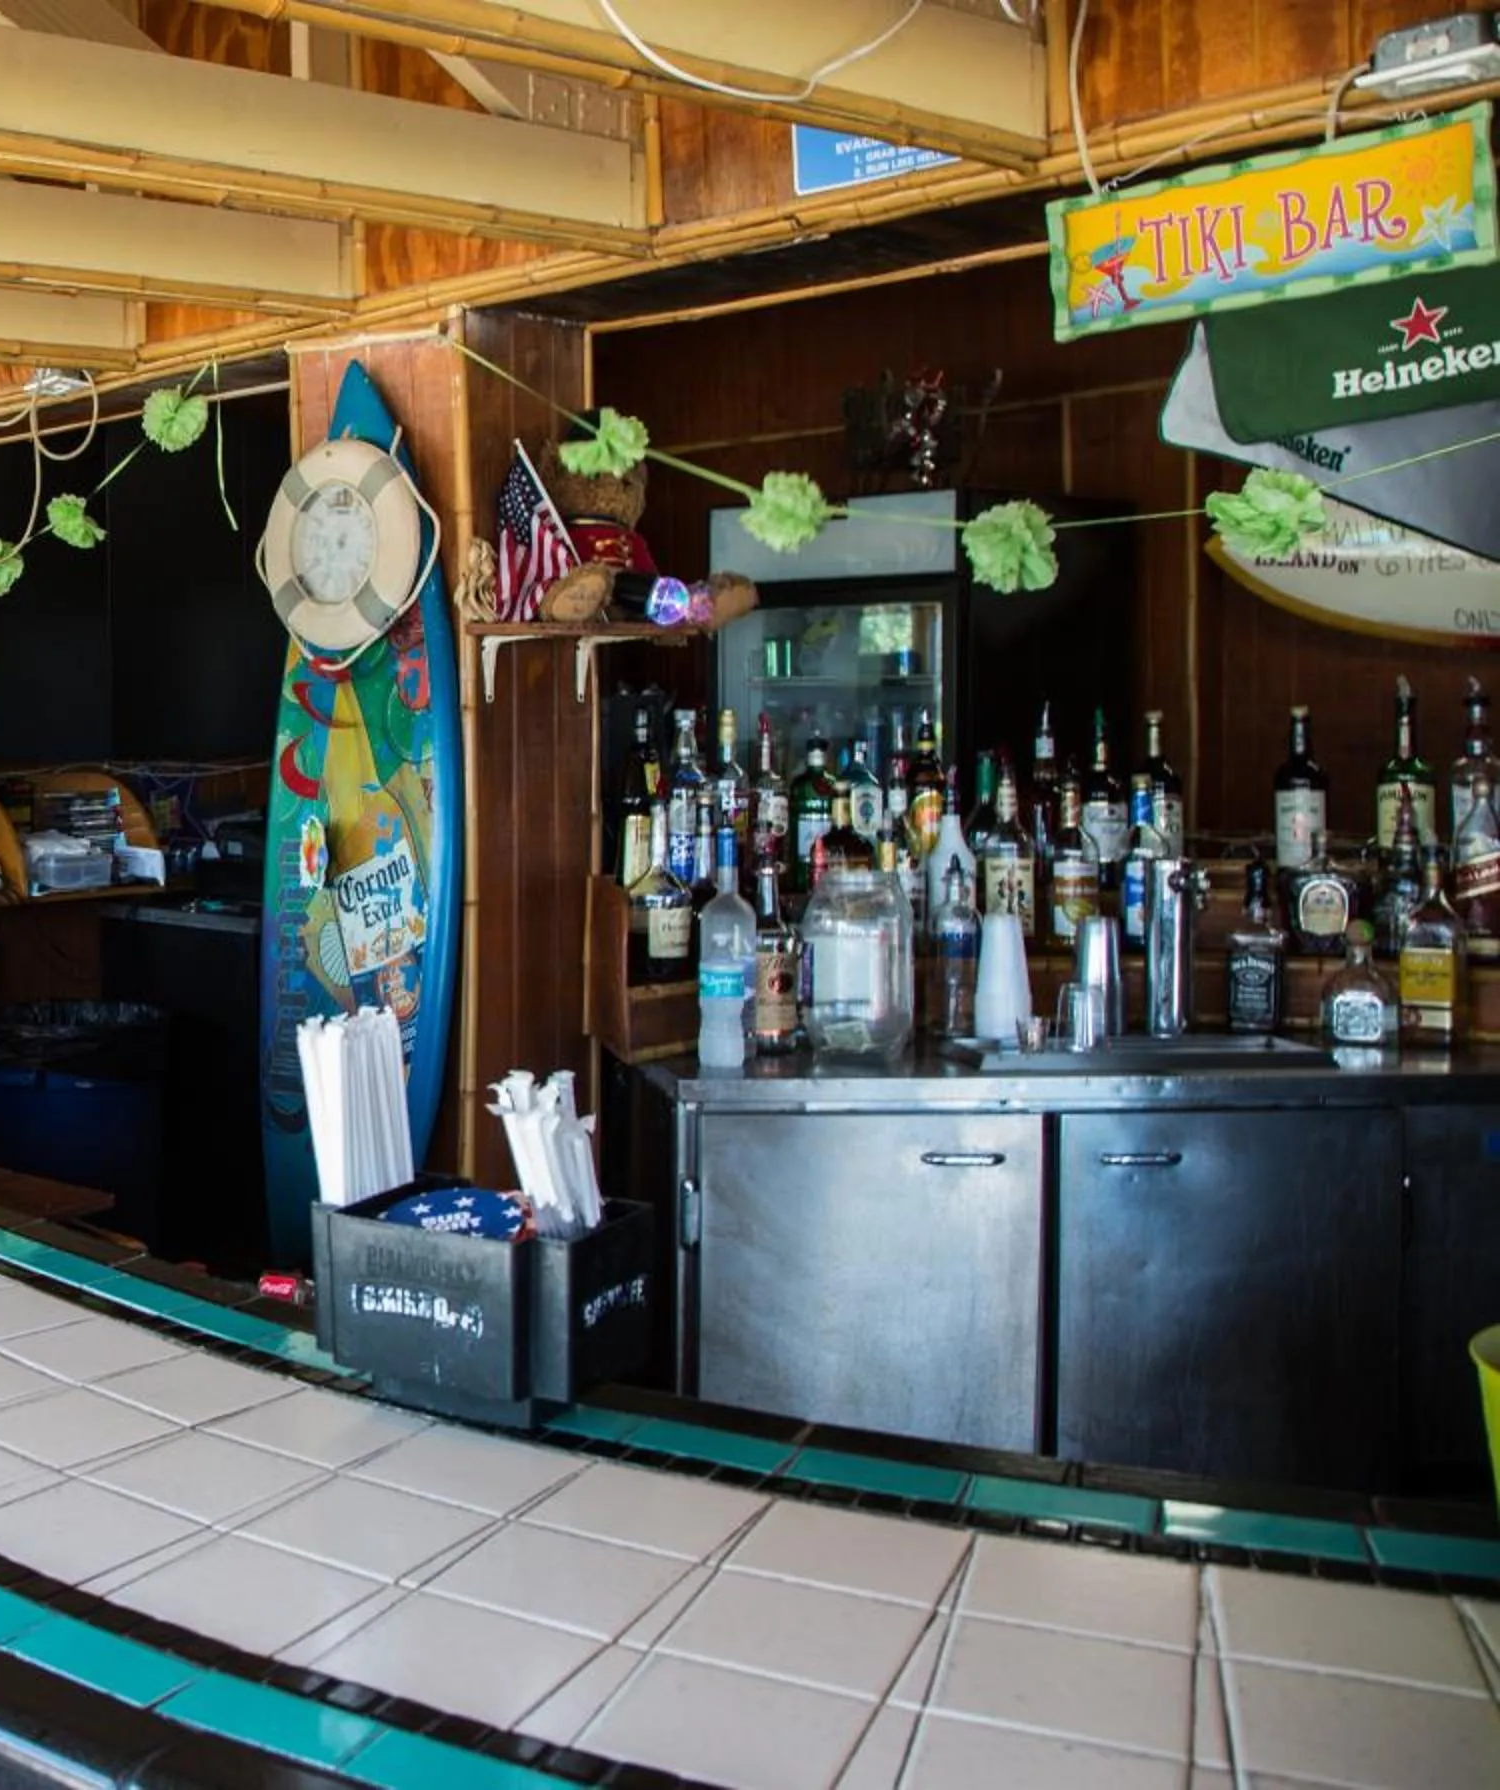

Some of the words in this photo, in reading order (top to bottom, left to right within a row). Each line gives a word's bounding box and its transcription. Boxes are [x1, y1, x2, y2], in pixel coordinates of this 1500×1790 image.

[1138, 204, 1247, 284] TIKI
[1277, 179, 1408, 263] BAR
[337, 853, 411, 914] Corona
[362, 894, 404, 929] Extra
